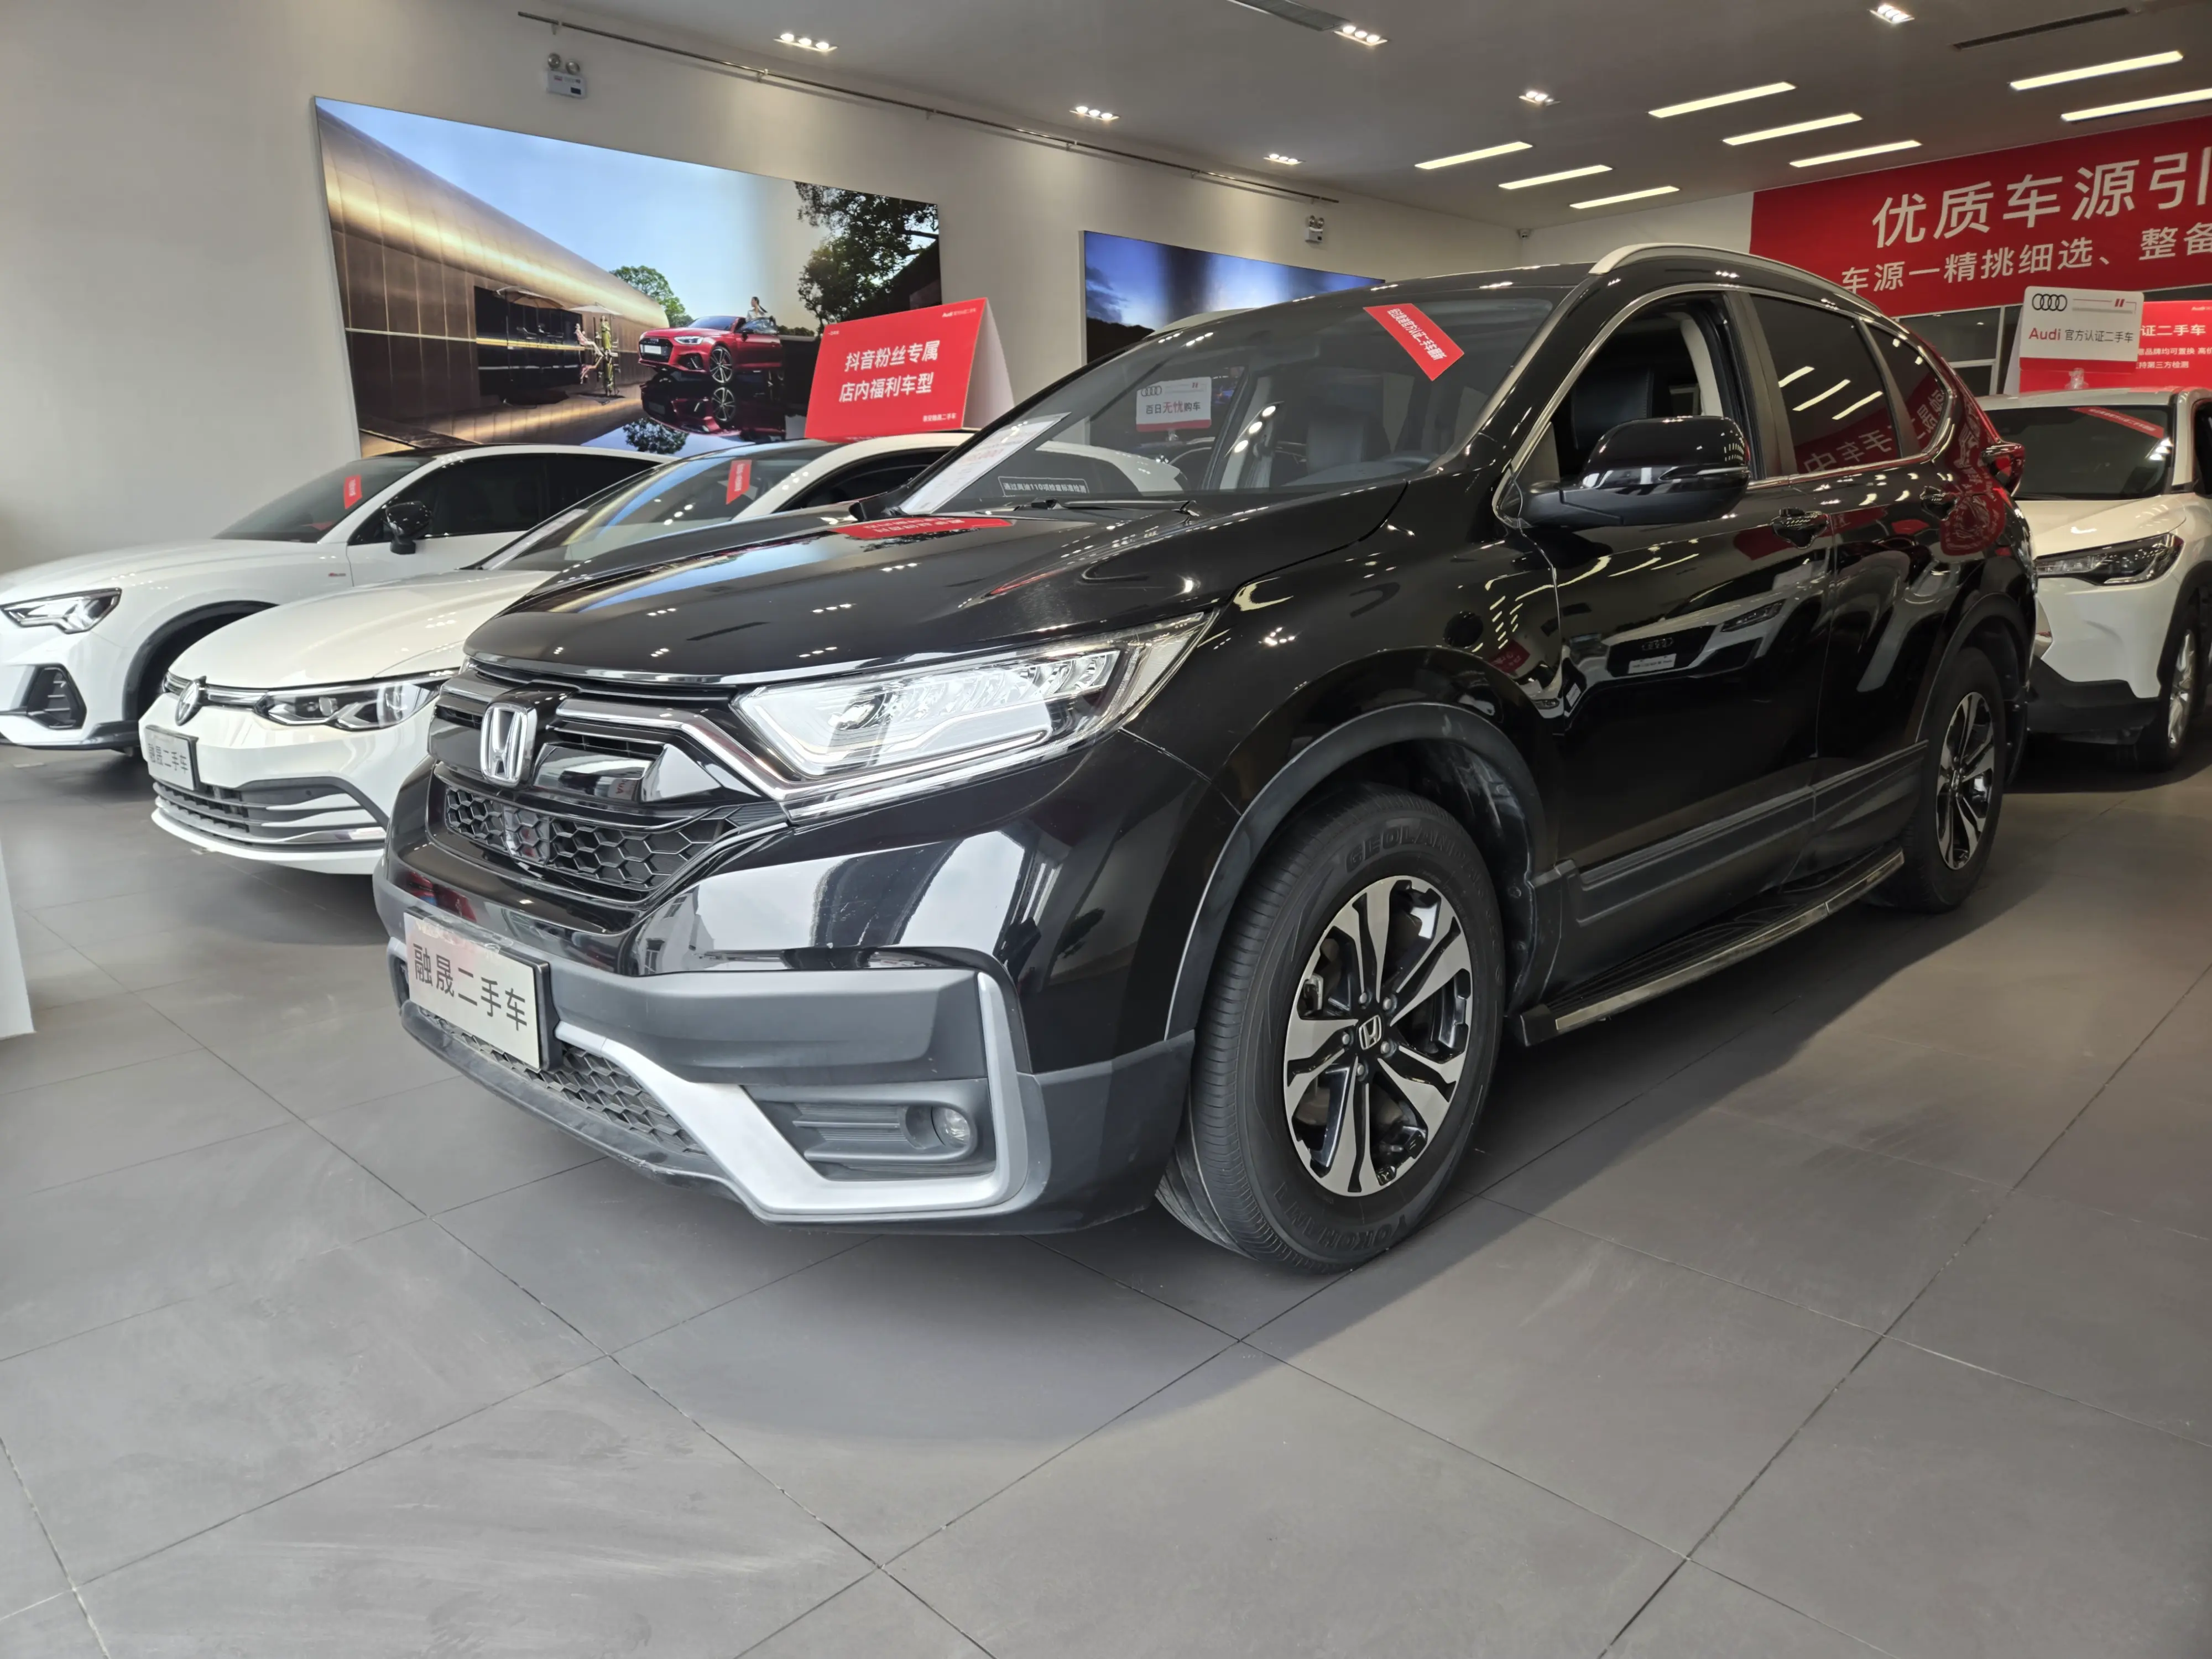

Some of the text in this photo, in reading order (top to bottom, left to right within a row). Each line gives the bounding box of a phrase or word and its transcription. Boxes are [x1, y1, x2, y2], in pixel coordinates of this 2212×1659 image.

[1872, 147, 2212, 248] 优质车源引
[2028, 327, 2133, 343] Audi 官方认证二手车
[844, 340, 940, 372] 抖音粉丝专属
[838, 372, 933, 403] 店内福利车型
[1146, 400, 1201, 414] 百日无忧购车
[413, 943, 527, 1031] 融晟二手车
